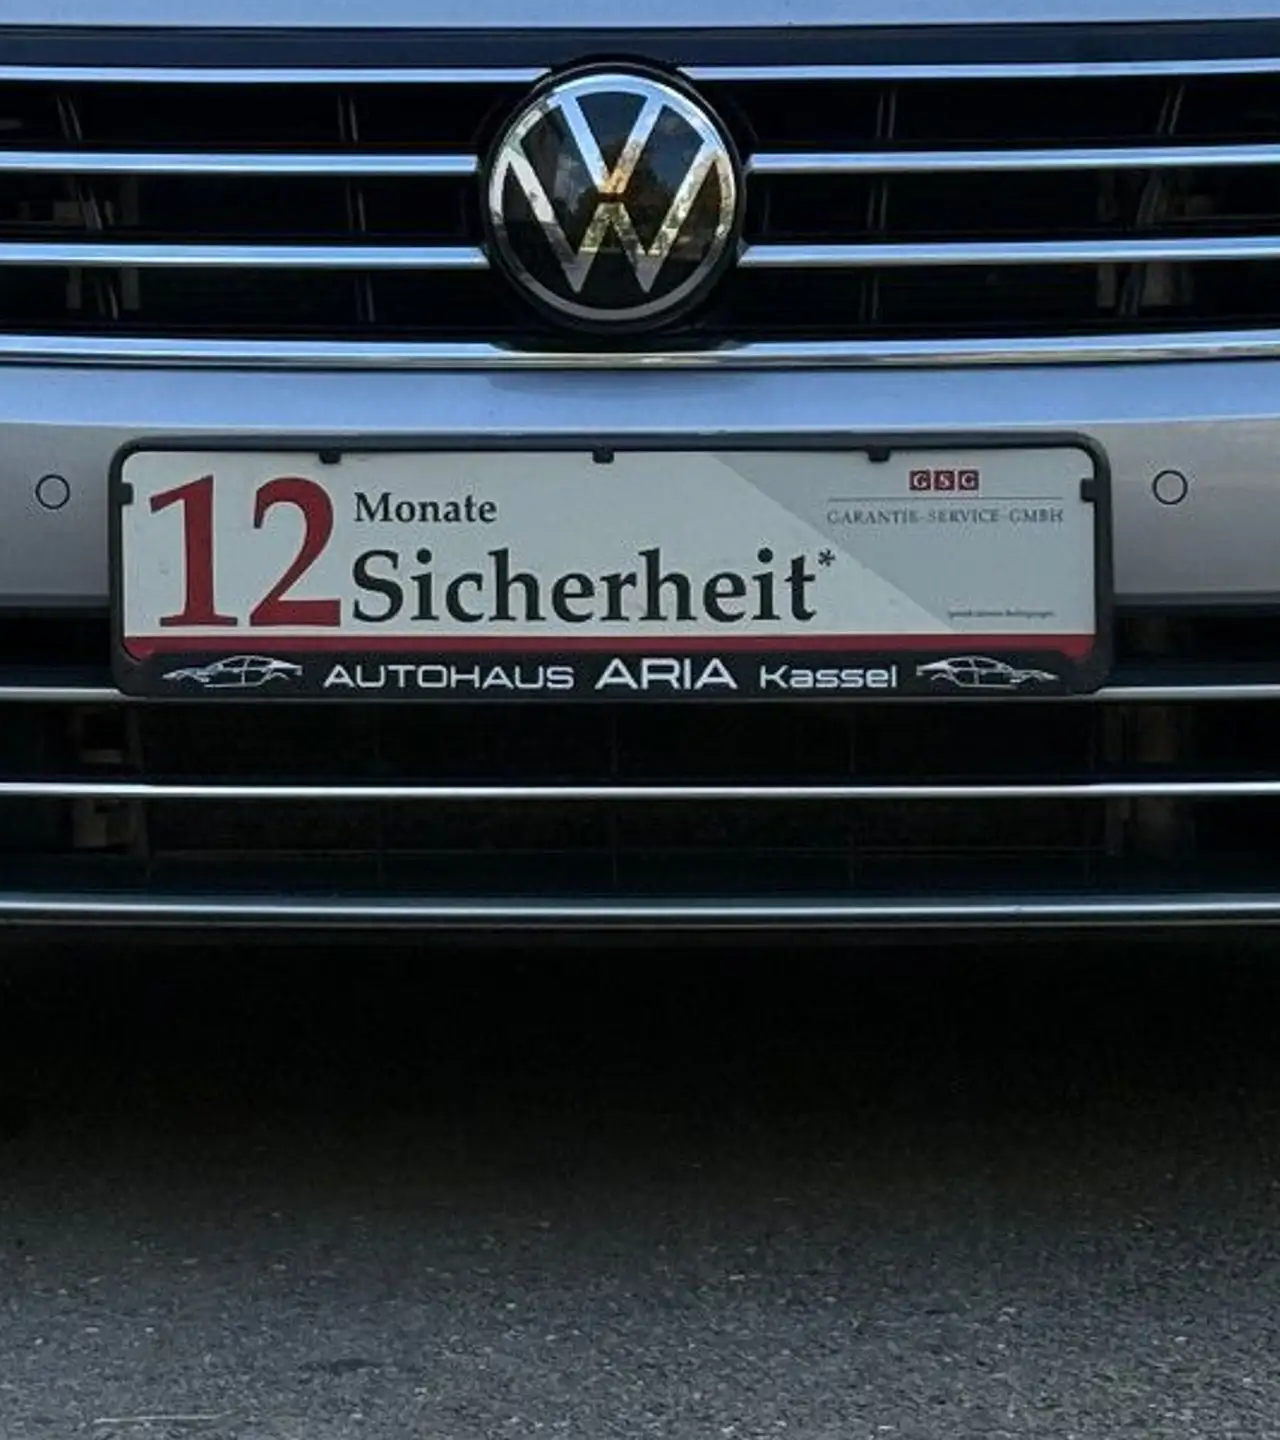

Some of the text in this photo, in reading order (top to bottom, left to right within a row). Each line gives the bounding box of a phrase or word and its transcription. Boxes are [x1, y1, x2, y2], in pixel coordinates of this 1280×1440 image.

[500, 80, 726, 294] VW
[909, 470, 979, 491] GSG
[150, 474, 498, 627] 12 Monate
[323, 657, 897, 690] AUTOHAUS ARIA Kassel
